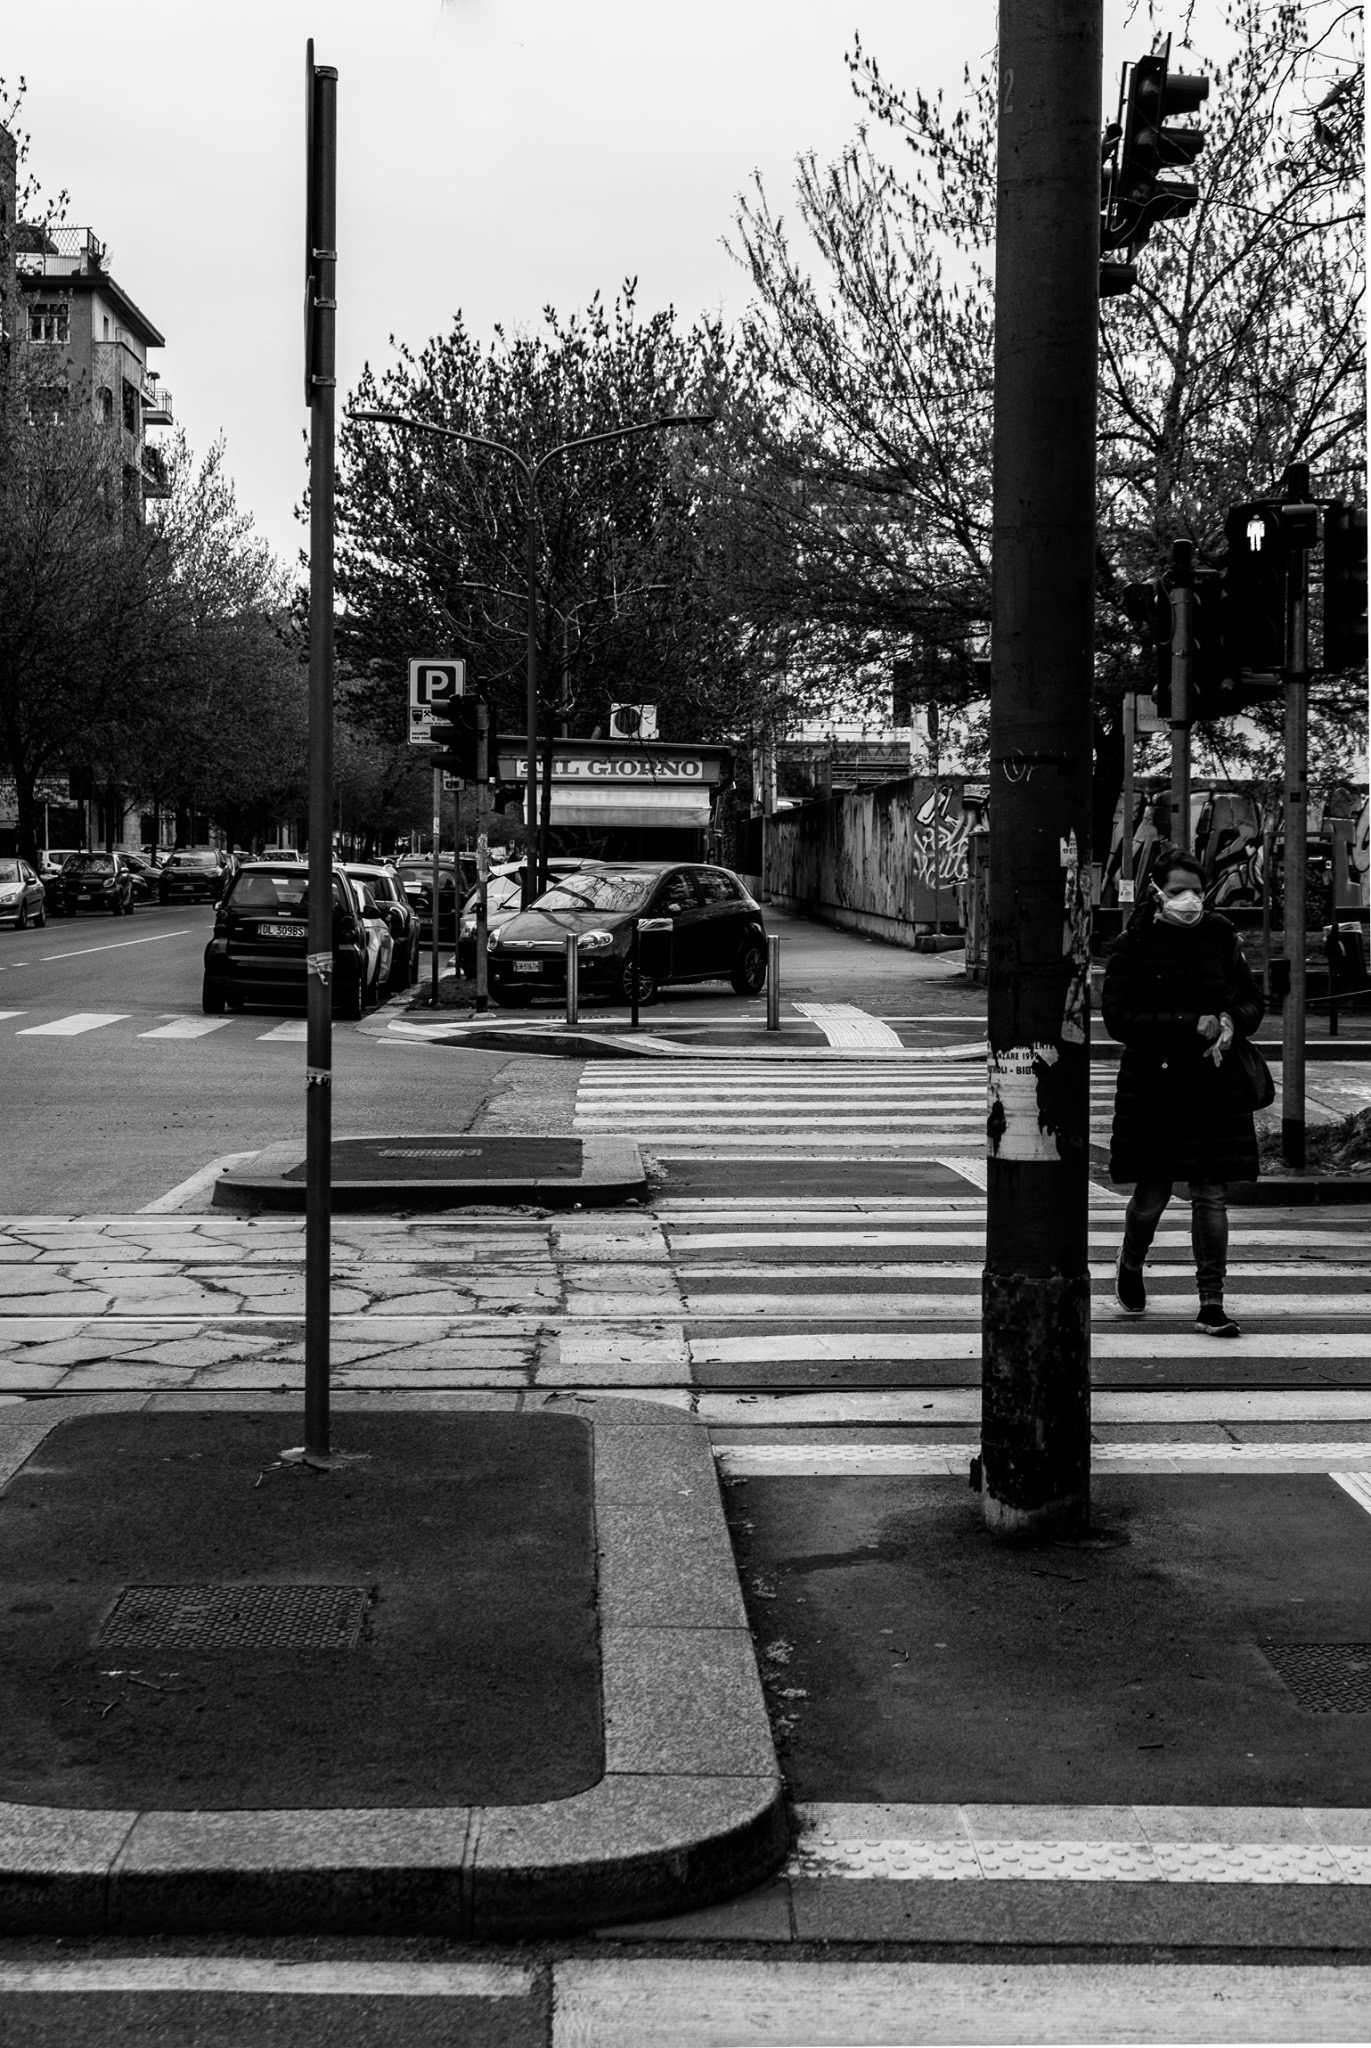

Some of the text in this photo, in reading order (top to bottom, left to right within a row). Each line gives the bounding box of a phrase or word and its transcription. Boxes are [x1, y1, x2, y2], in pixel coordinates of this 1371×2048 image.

[1003, 68, 1014, 114] 2
[426, 670, 449, 700] P
[588, 760, 700, 776] GIORNO
[262, 925, 304, 936] DL 309BS
